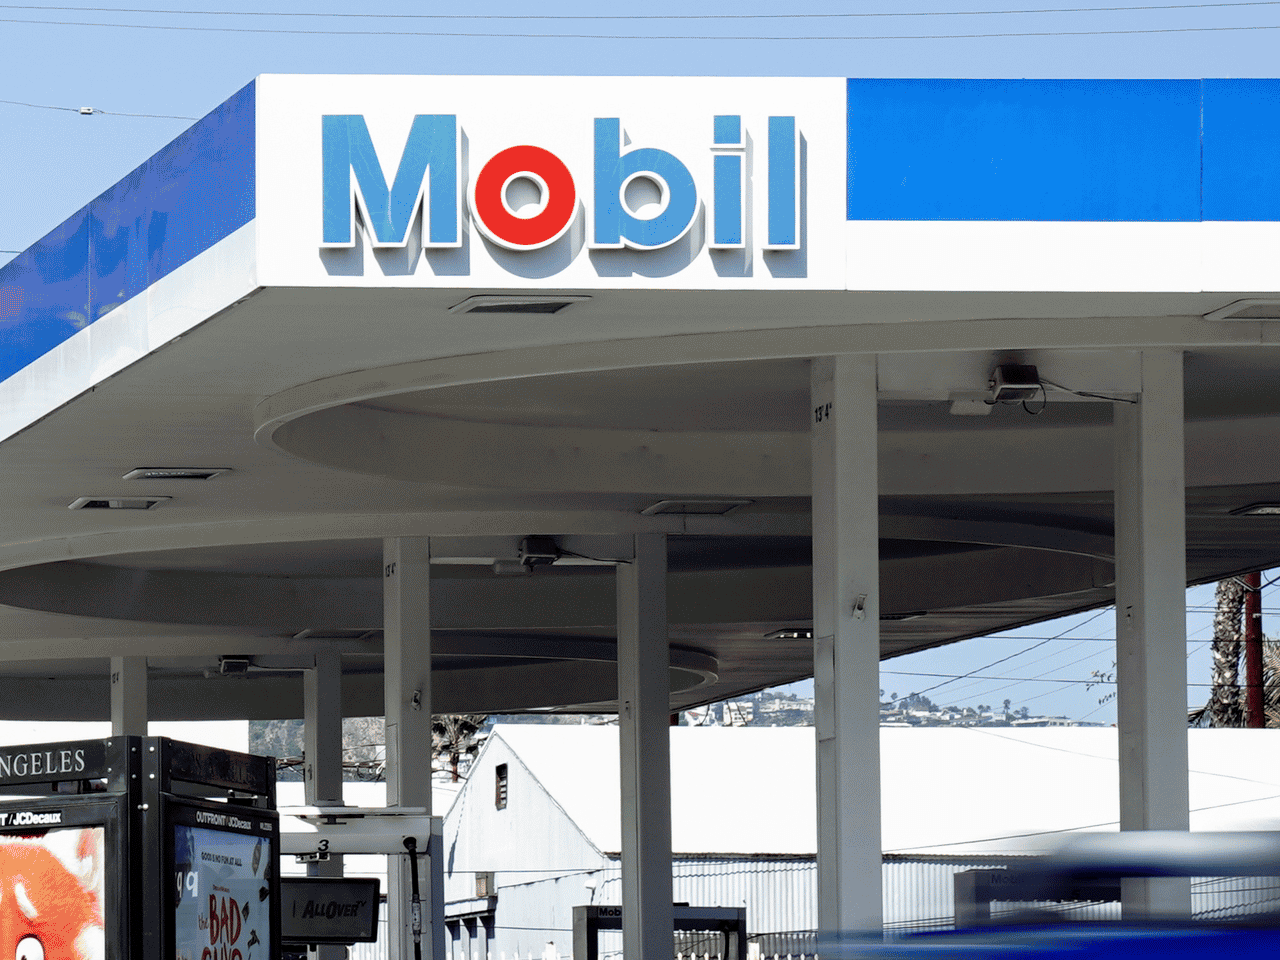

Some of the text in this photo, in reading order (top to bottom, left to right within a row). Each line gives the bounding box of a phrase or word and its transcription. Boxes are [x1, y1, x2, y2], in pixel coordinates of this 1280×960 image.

[320, 113, 802, 252] Mobil
[13, 810, 62, 826] JCDecaux
[318, 839, 329, 852] 3
[209, 893, 242, 946] BAD
[599, 907, 622, 917] Mob
